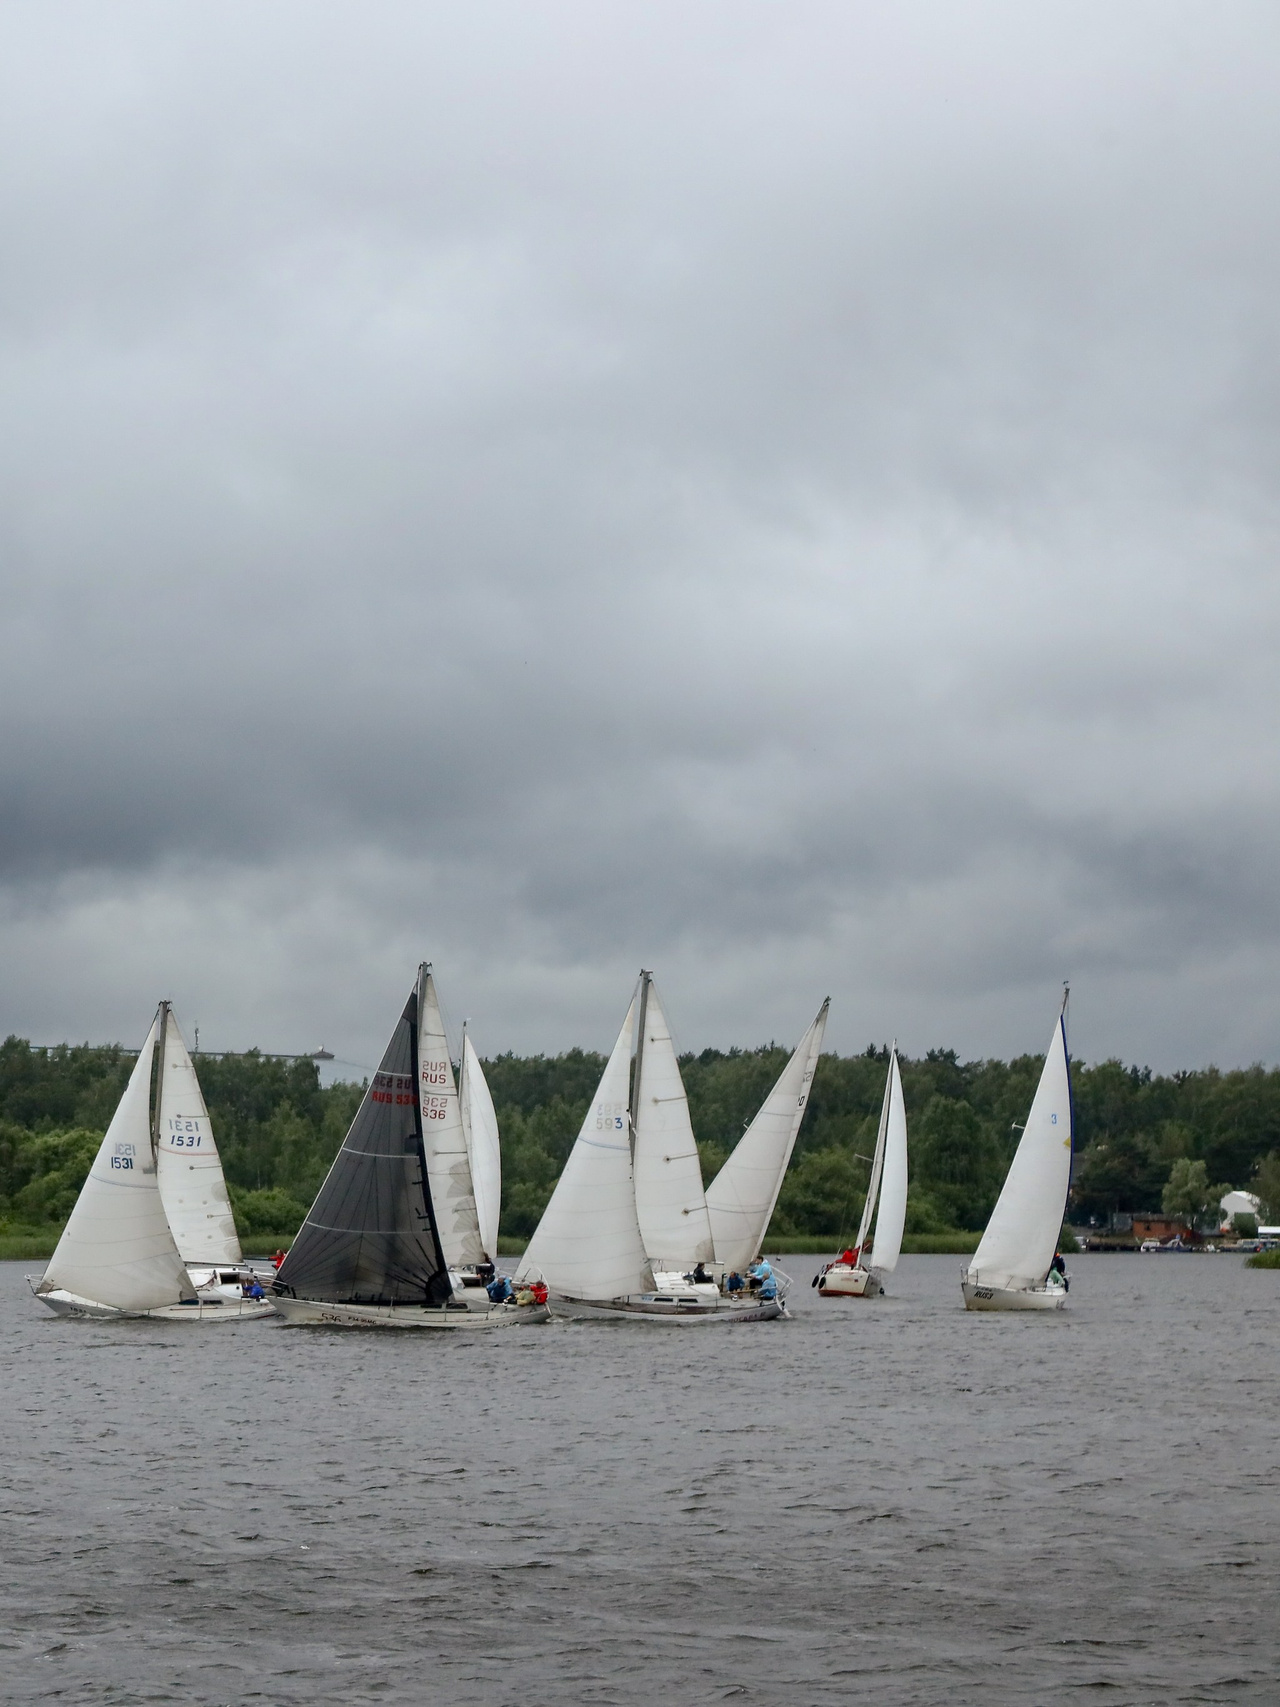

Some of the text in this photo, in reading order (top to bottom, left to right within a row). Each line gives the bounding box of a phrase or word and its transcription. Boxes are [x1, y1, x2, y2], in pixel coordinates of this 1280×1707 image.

[422, 1071, 447, 1084] RUS
[372, 1091, 393, 1104] RUS
[422, 1106, 446, 1120] 536
[1051, 1113, 1057, 1125] 3
[596, 1117, 623, 1130] 593
[170, 1135, 201, 1147] 1531
[111, 1156, 134, 1169] 1531
